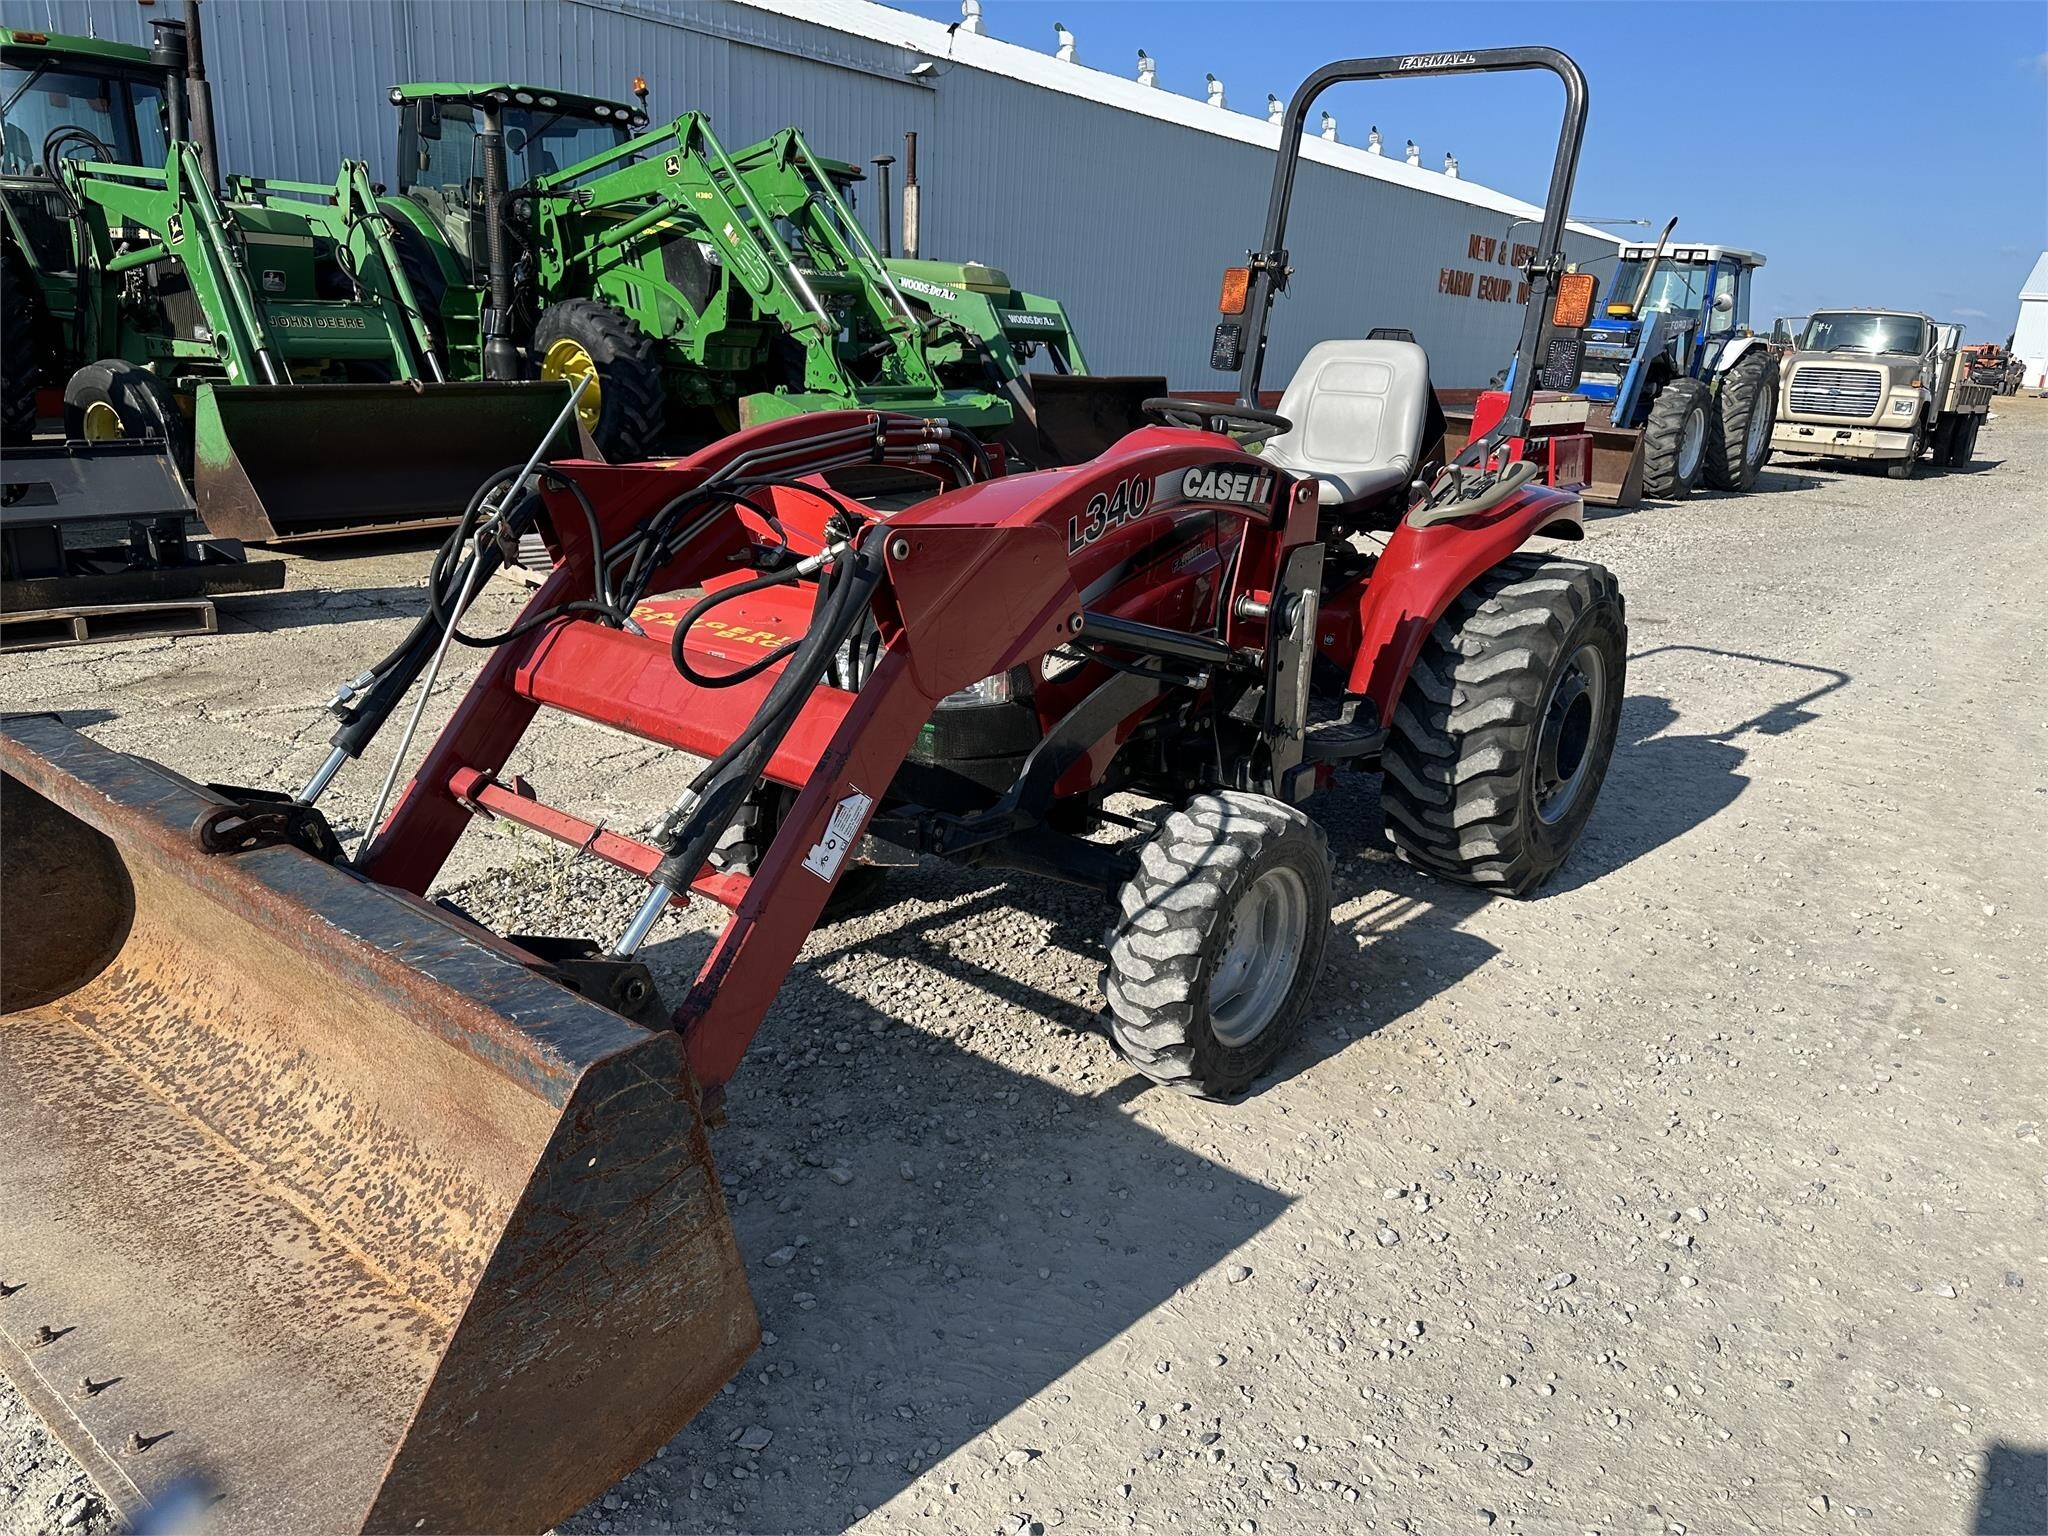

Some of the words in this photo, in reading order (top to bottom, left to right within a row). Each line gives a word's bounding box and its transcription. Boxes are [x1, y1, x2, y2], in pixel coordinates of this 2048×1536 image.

[1399, 53, 1476, 70] FARMALL
[1467, 233, 1497, 263] NEW
[1498, 240, 1508, 267] &
[1510, 242, 1538, 267] USE
[1438, 267, 1474, 298] FARM
[270, 315, 313, 328] JOHN
[315, 317, 366, 329] DEERE
[1818, 322, 1833, 335] #4
[1068, 472, 1151, 557] L340
[712, 629, 783, 649] BAC
